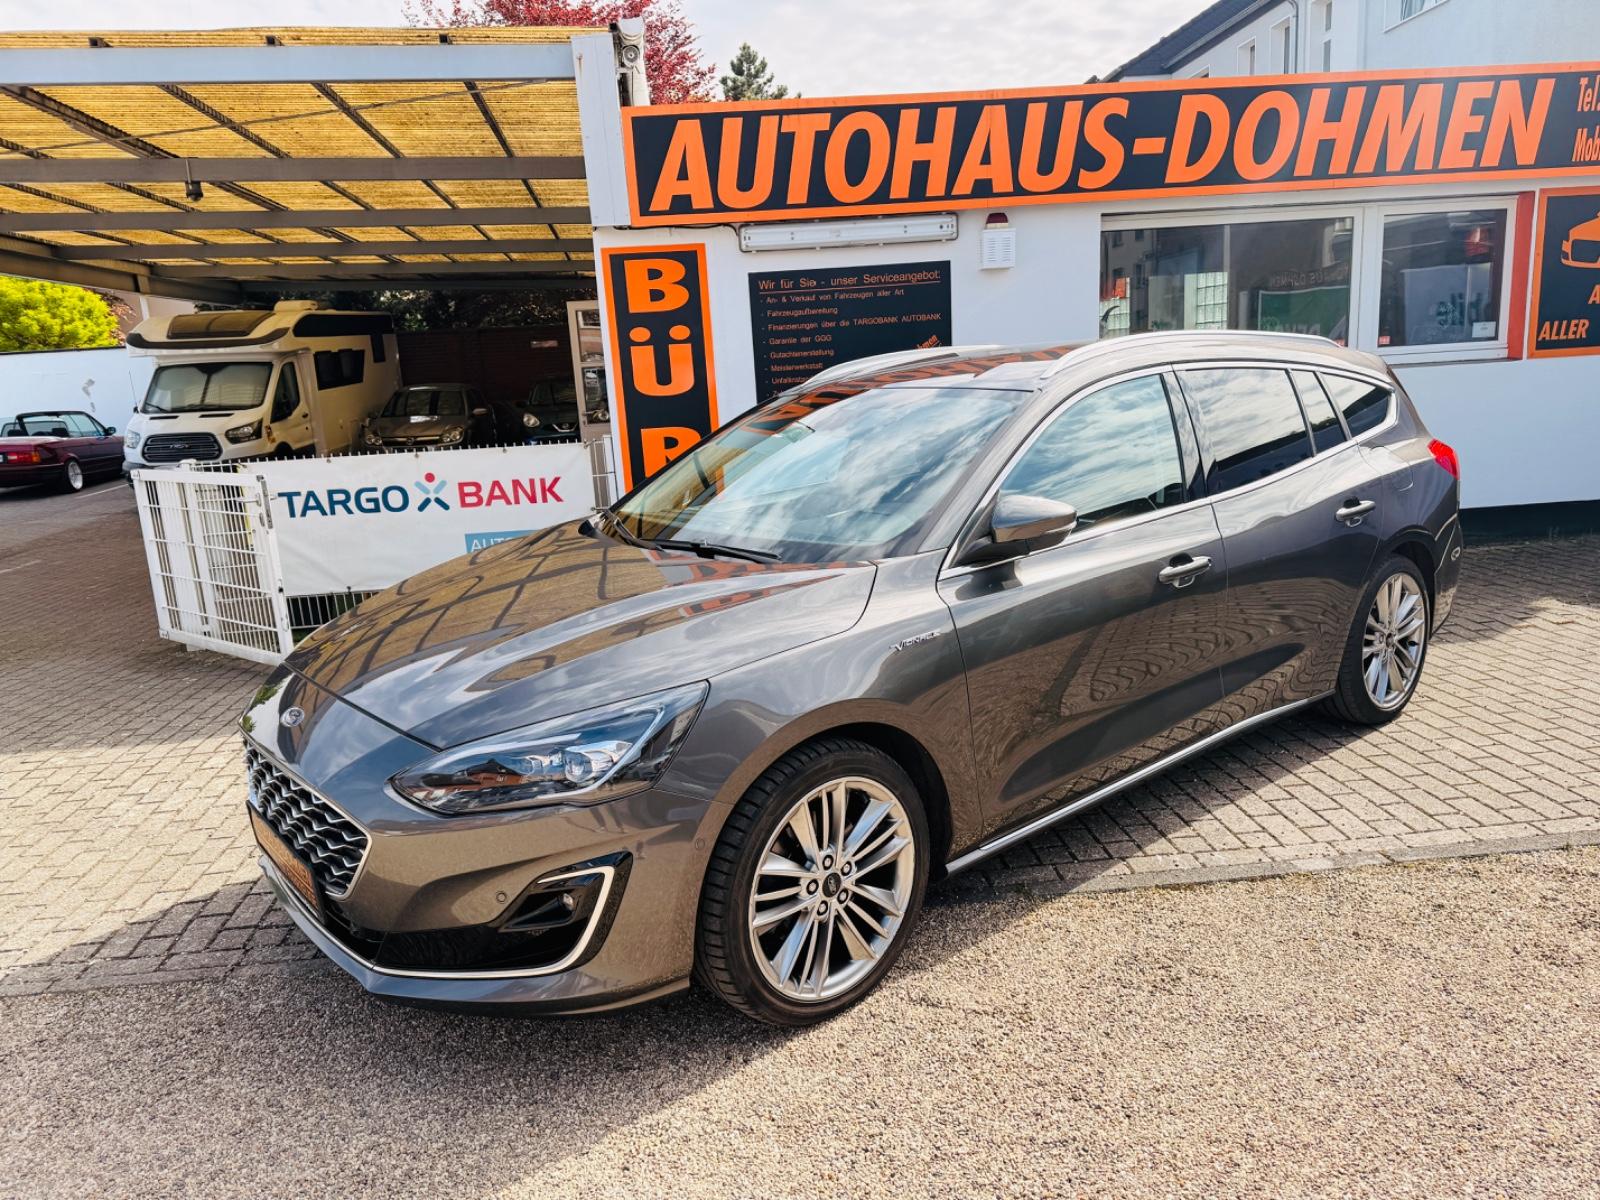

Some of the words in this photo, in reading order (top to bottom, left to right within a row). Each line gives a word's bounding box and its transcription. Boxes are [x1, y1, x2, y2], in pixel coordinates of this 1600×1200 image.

[648, 77, 1556, 212] AUTOHAUS-DOHMEN
[758, 279, 776, 290] Wir
[780, 278, 795, 289] für
[799, 277, 817, 288] Sie
[830, 275, 859, 286] unser
[863, 270, 941, 284] Serviceangebot:
[790, 294, 816, 302] Verkauf
[819, 293, 832, 301] von
[834, 290, 874, 300] Fahrzeugen
[894, 288, 905, 296] Art
[766, 306, 839, 318] Fahrzeugaufbereitung
[821, 319, 837, 328] über
[853, 315, 899, 326] TARGOBANK
[901, 312, 942, 323] AUTOBANK
[1537, 318, 1590, 341] ALLER
[277, 484, 410, 519] TARGO
[457, 475, 564, 508] BANK
